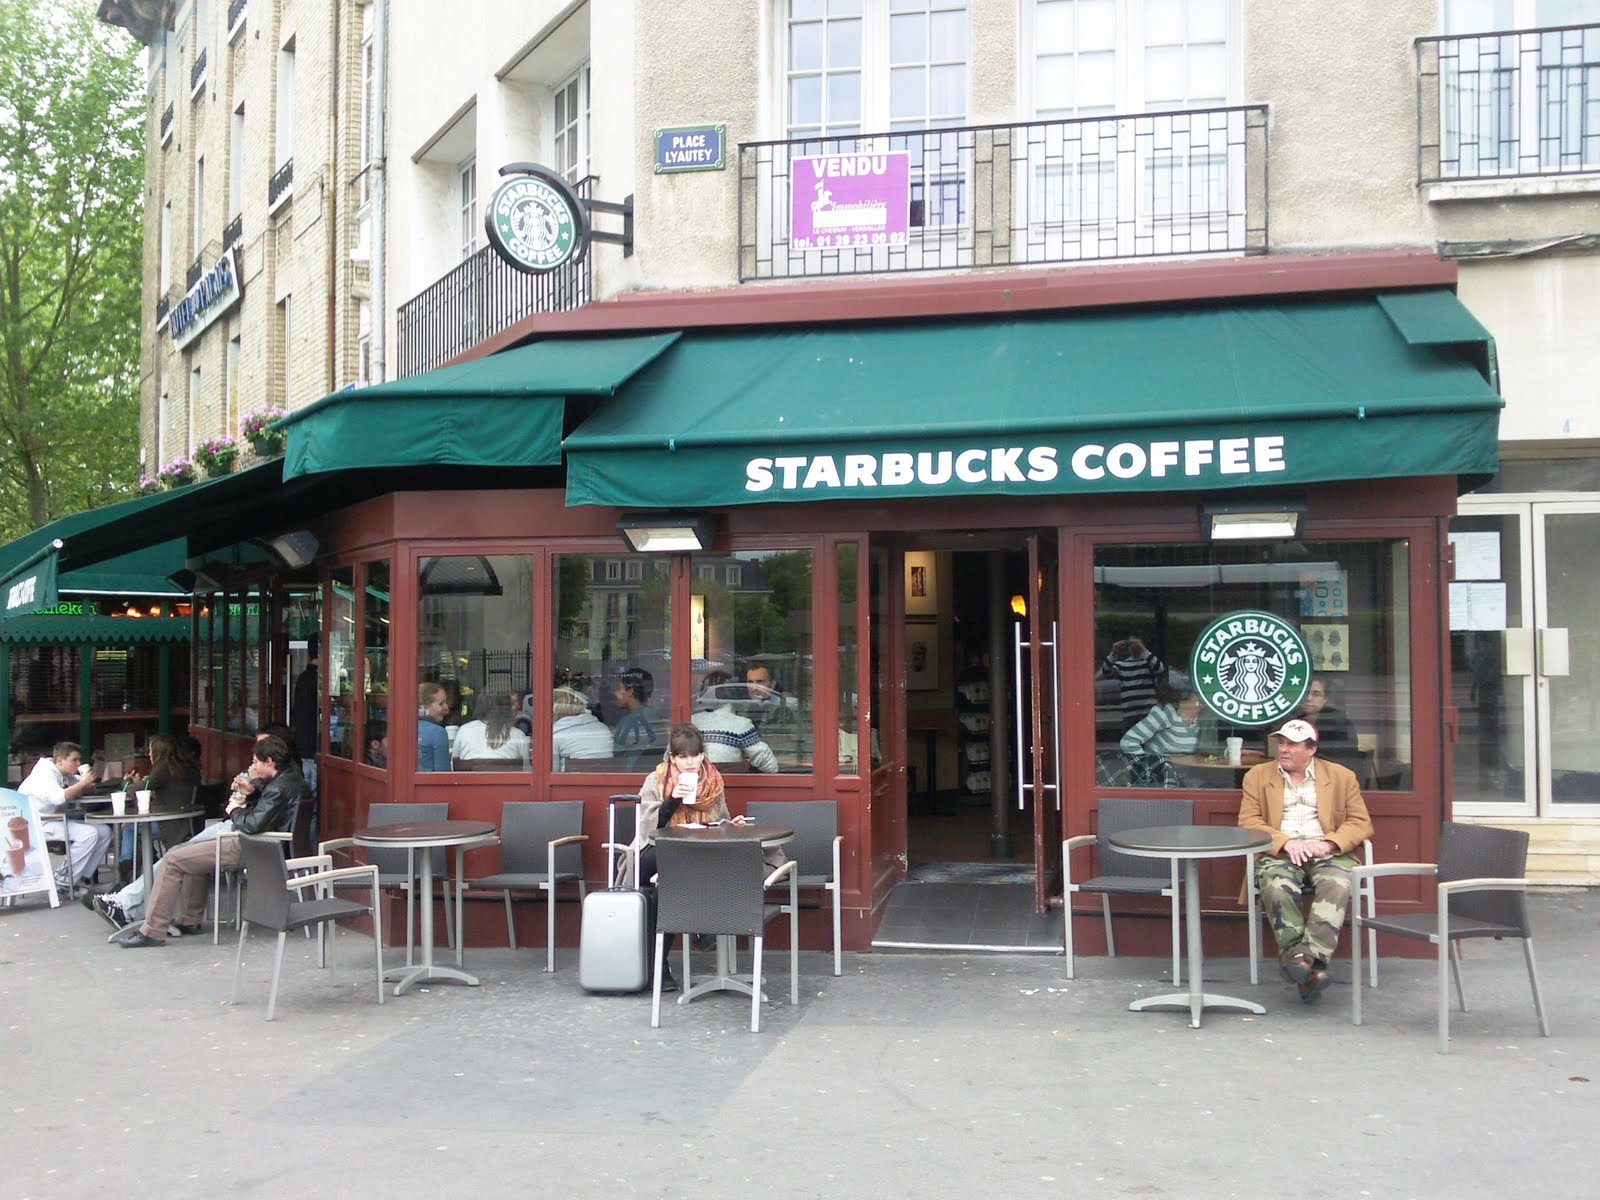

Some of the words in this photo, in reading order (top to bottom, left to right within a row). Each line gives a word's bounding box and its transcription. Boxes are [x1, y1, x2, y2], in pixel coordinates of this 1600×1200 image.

[665, 148, 713, 164] LYAUTEY
[672, 135, 706, 149] PLACE
[811, 155, 888, 179] VENDU
[497, 183, 570, 225] STARBUCKS
[508, 237, 564, 265] COFFEE
[743, 446, 1059, 492] STARBUCKS
[1071, 436, 1287, 481] COFFEE
[1200, 618, 1303, 666] STARBUCKS
[1212, 691, 1292, 720] COFFEE
